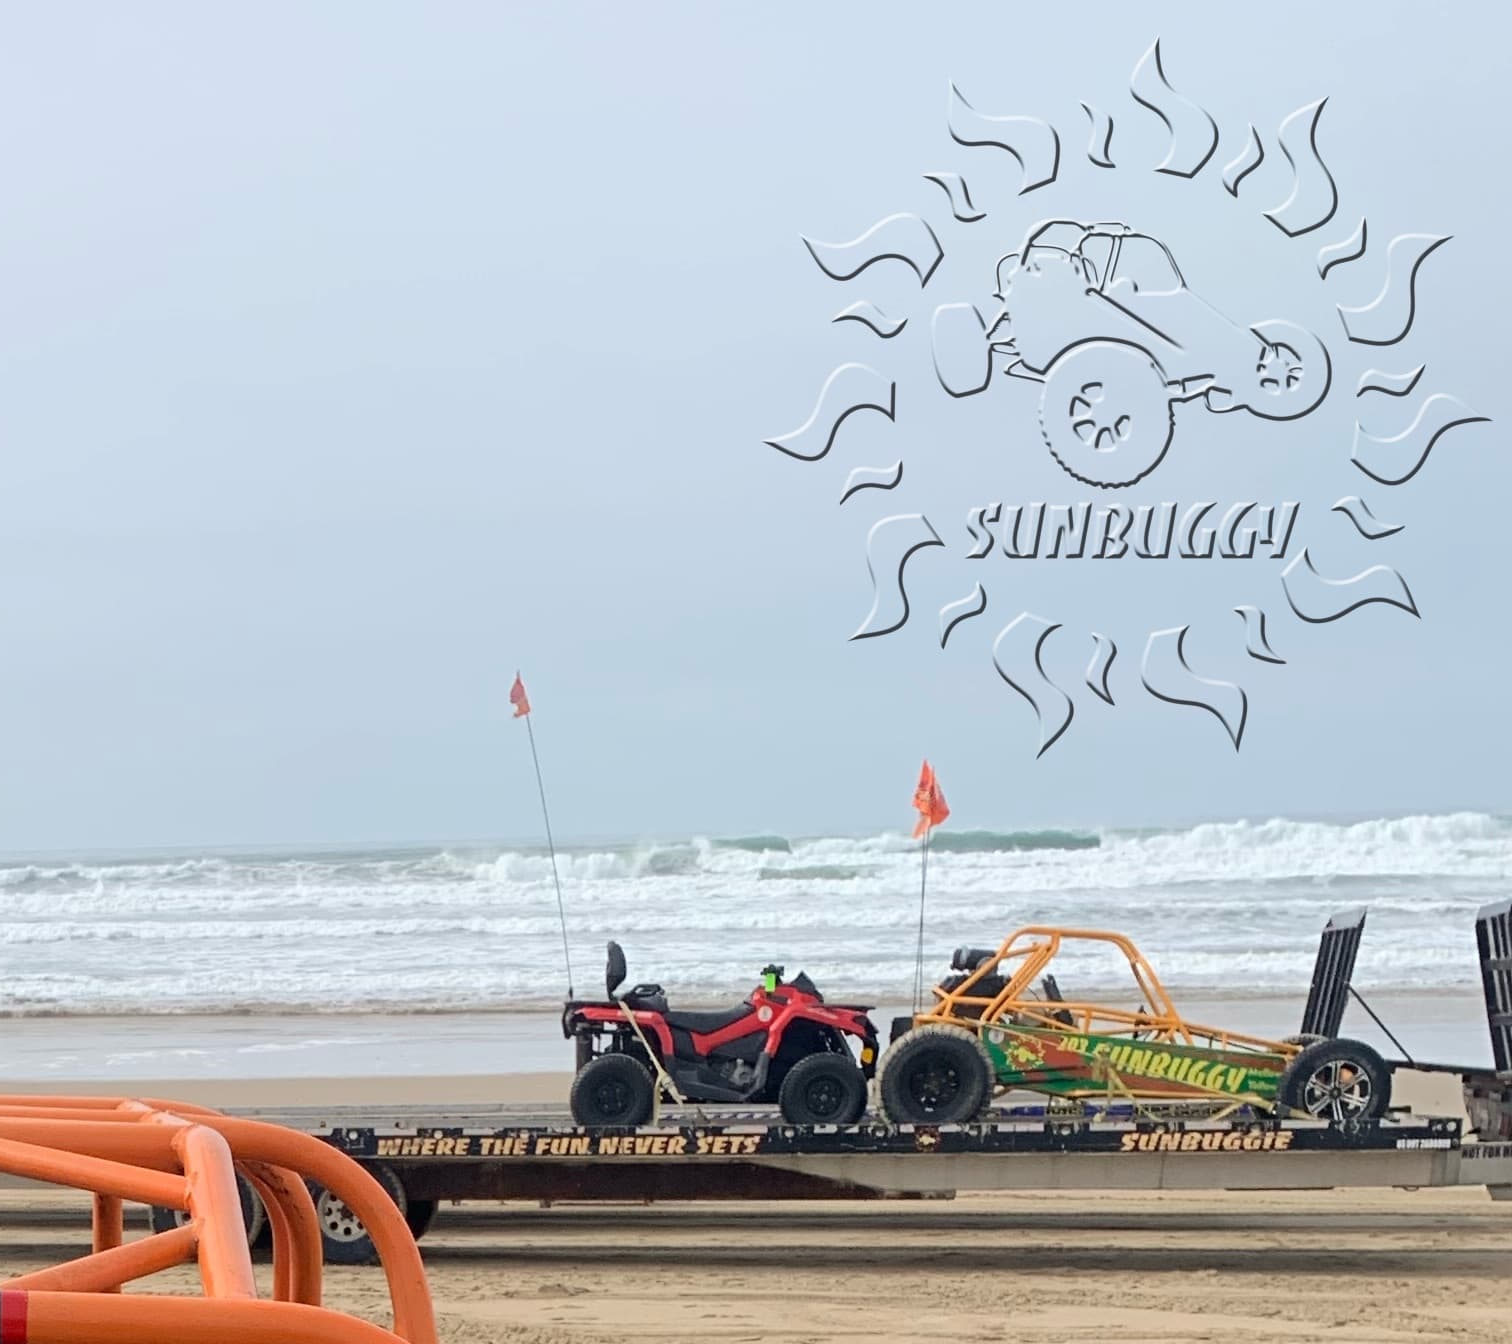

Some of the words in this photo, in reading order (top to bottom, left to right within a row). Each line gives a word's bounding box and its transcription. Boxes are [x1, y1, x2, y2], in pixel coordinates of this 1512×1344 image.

[377, 1138, 471, 1156] WHERE
[479, 1138, 529, 1156] THE
[535, 1138, 591, 1156] FUN
[599, 1136, 687, 1155] NEVER
[696, 1136, 760, 1154] SETS
[1121, 1131, 1293, 1151] SUNBUGGIE
